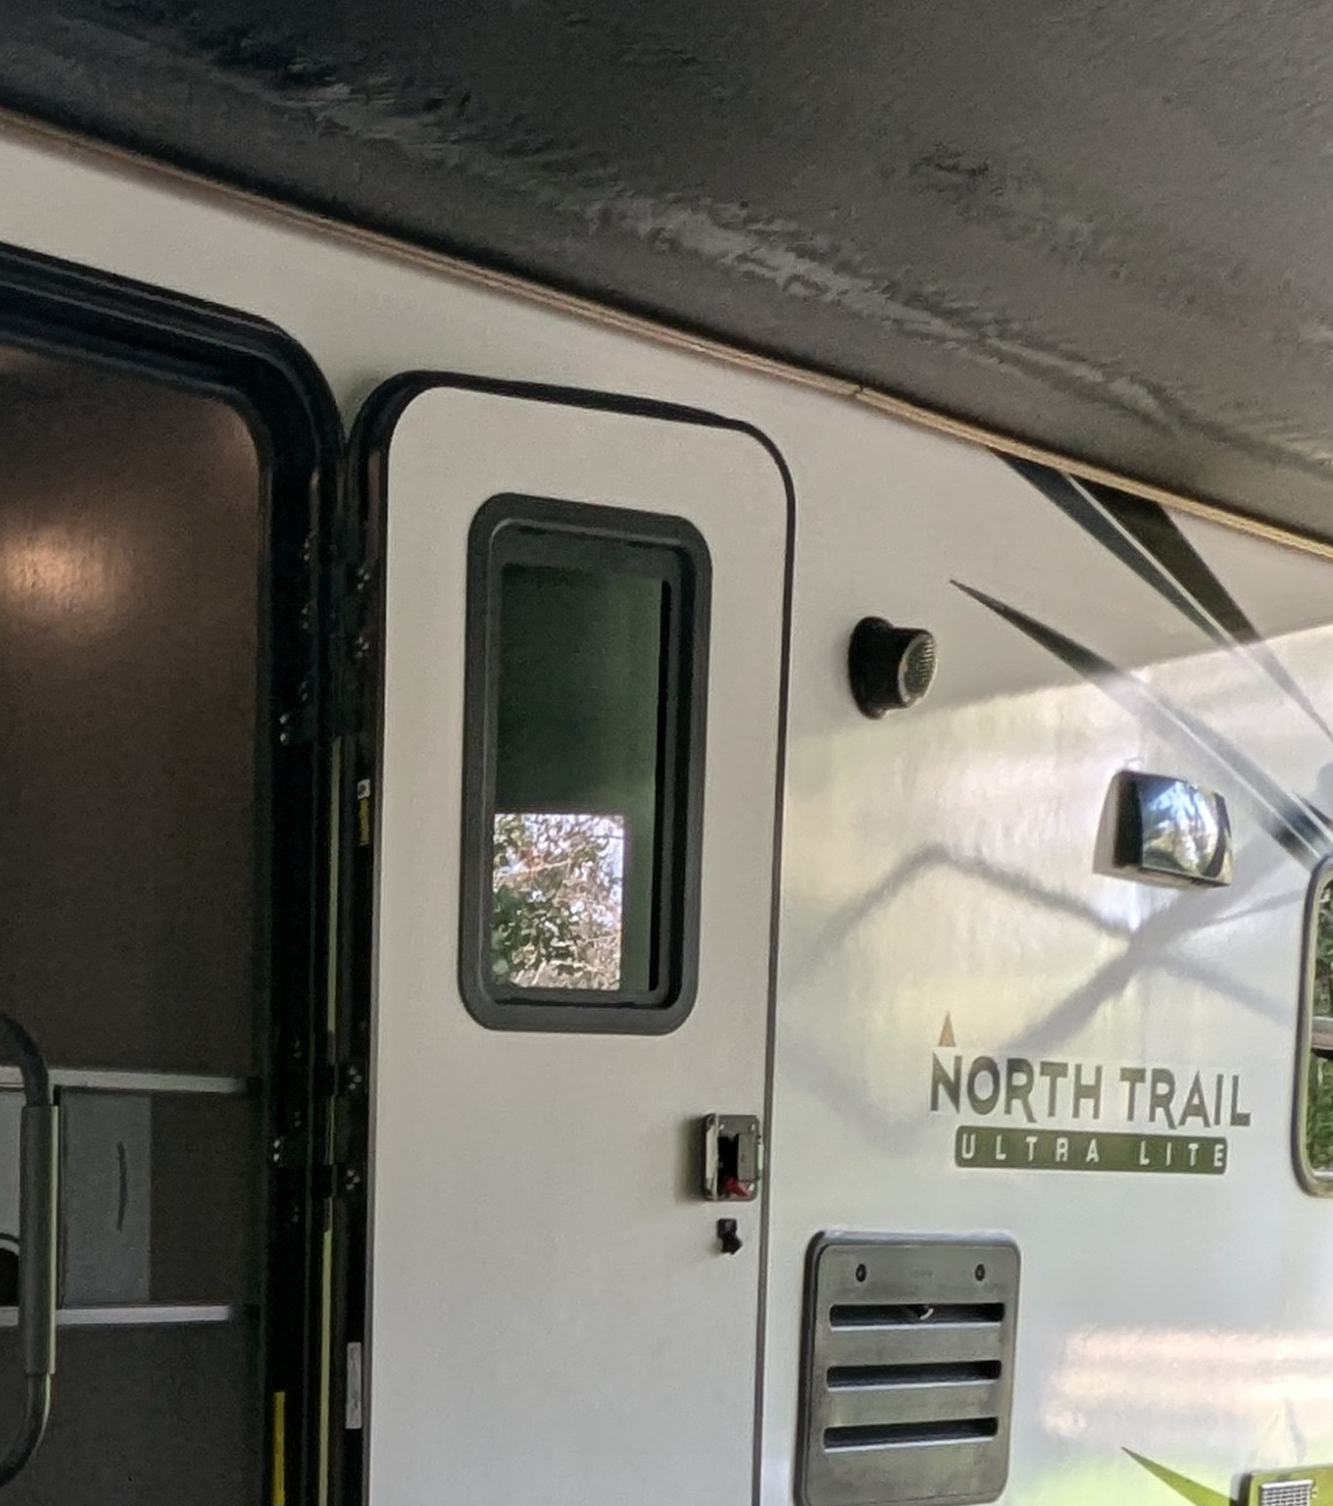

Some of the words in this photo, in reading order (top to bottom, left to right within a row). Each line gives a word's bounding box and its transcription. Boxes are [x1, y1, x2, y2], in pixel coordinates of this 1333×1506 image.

[930, 1052, 1103, 1123] NORTH
[1120, 1065, 1251, 1129] TRAIL
[961, 1135, 1099, 1163] ULTRA
[1140, 1140, 1225, 1167] LITE
